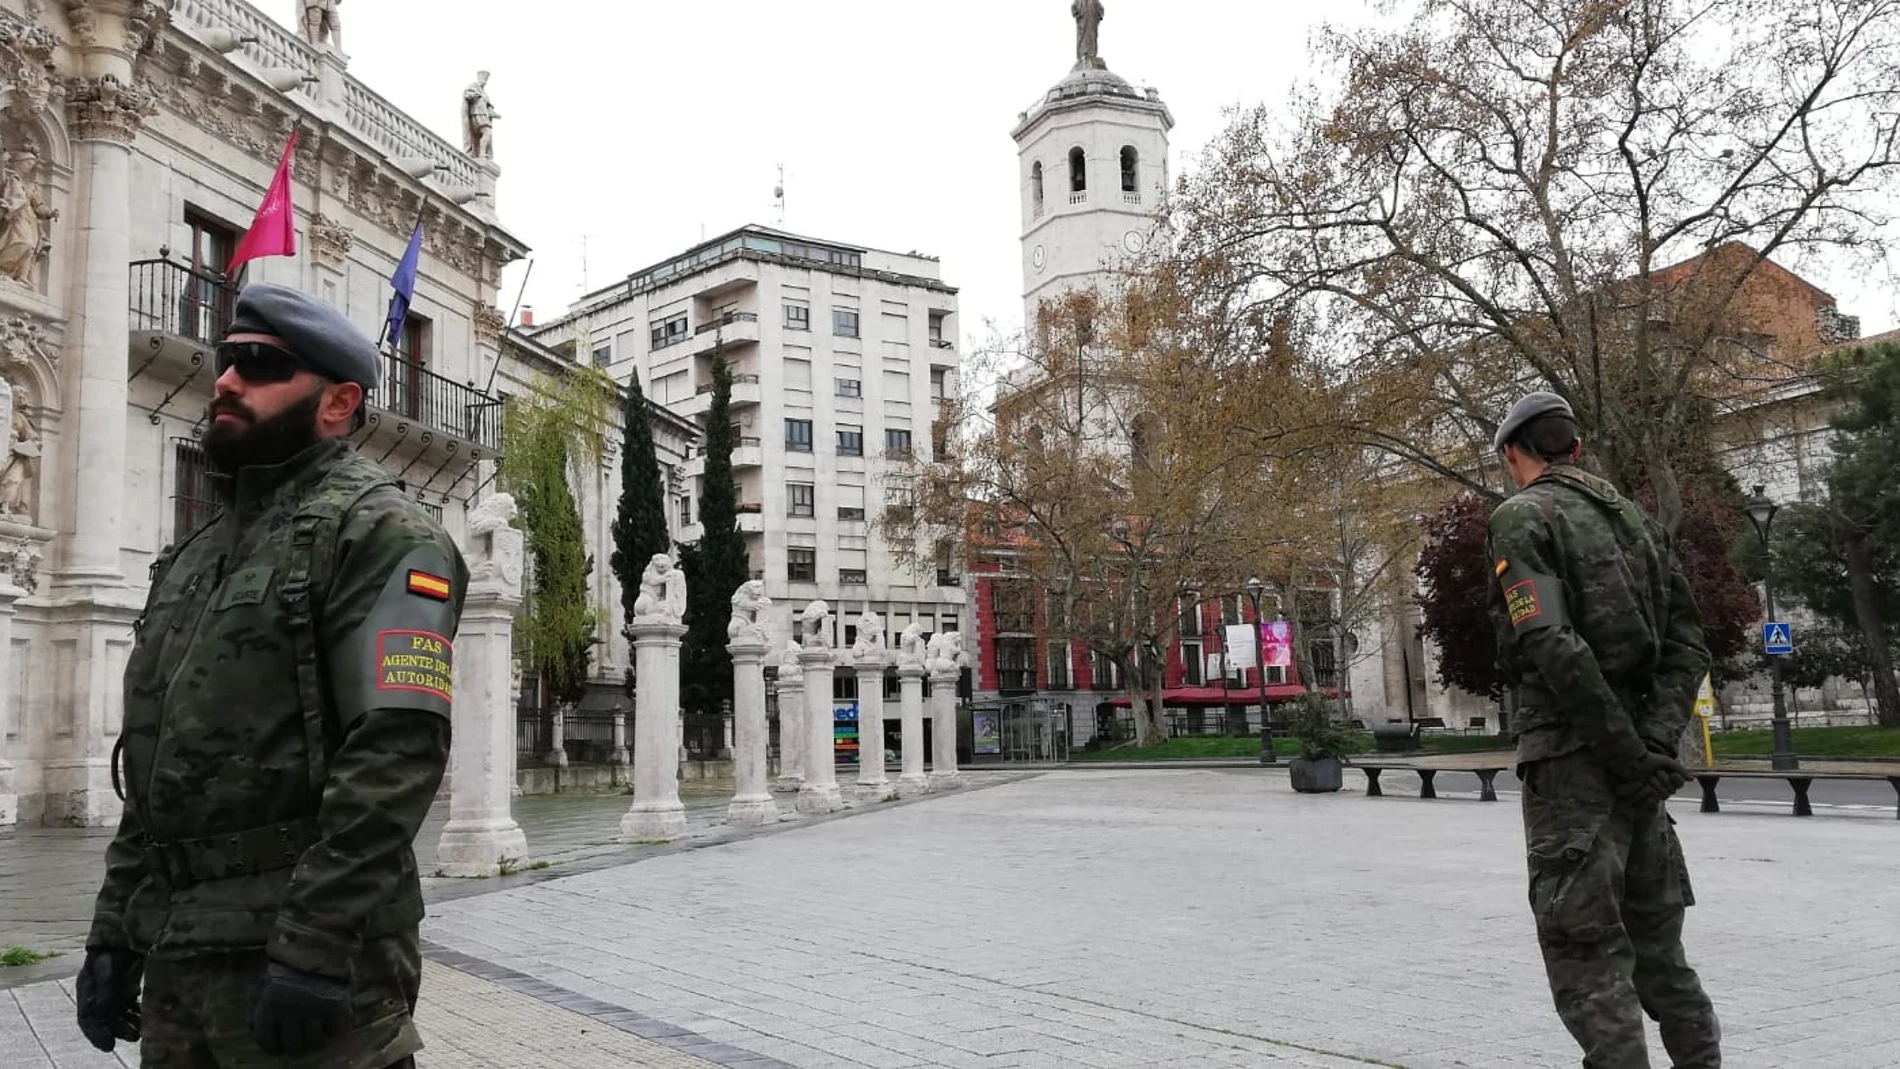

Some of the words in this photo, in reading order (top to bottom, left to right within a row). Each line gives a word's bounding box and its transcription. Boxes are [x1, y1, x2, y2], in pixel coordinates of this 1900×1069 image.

[411, 636, 442, 654] FAS
[383, 654, 433, 670] AGENTE
[385, 671, 452, 695] AUTORIDA
[833, 700, 859, 720] ed
